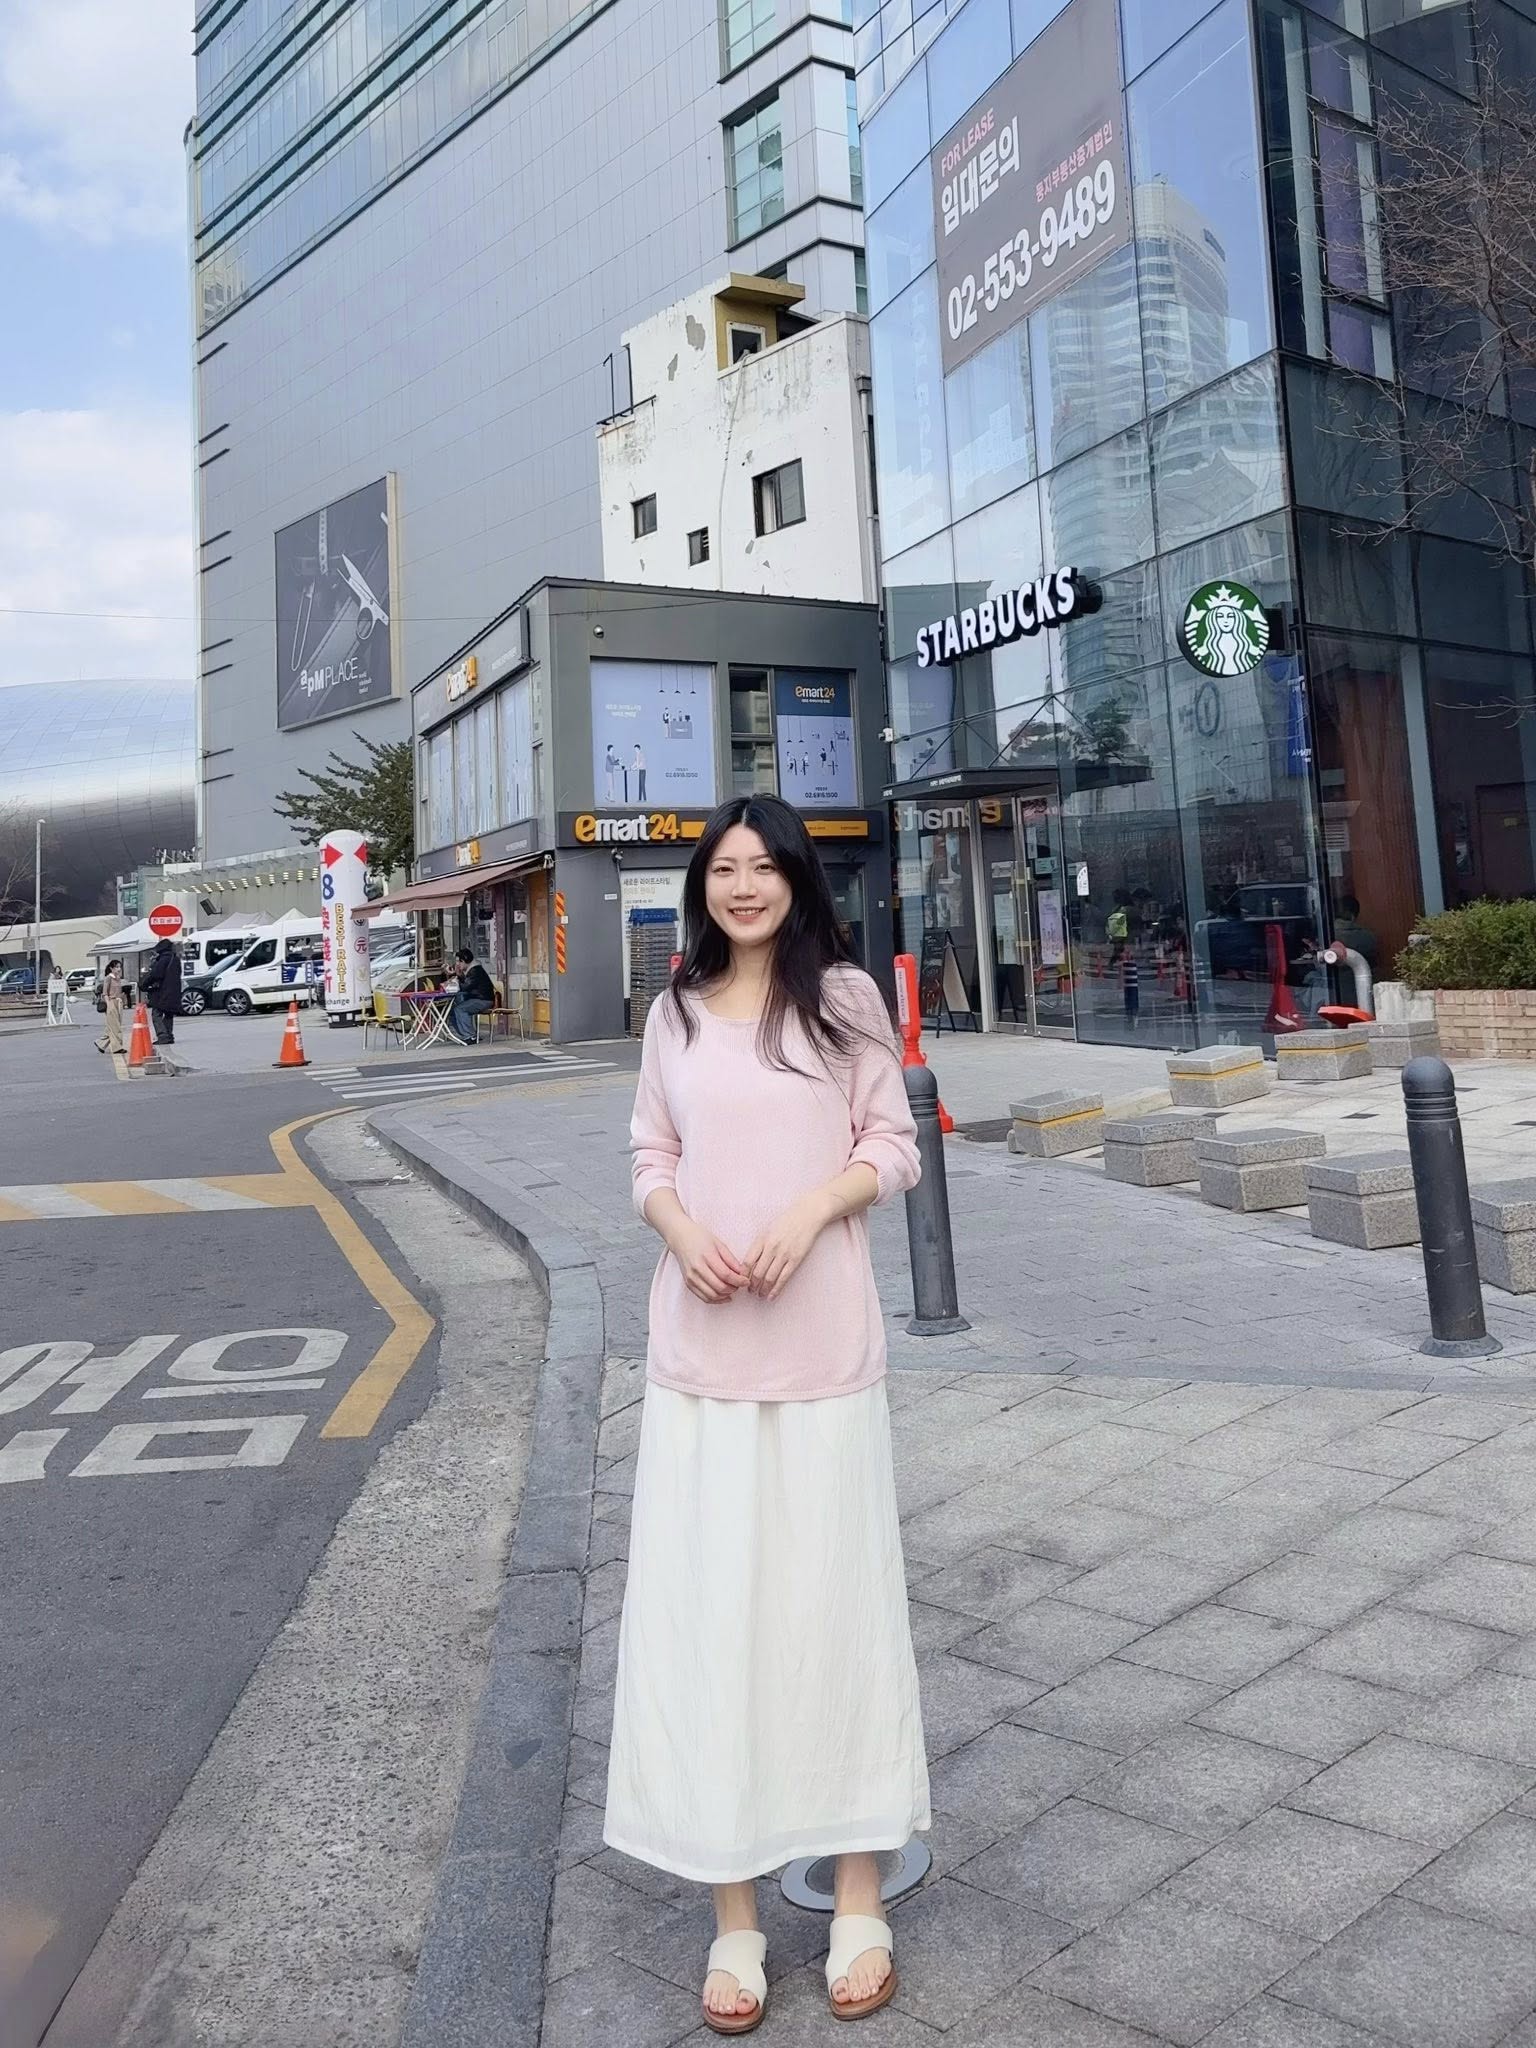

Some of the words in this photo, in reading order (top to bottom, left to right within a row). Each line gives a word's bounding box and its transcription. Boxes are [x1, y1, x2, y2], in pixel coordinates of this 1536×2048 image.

[941, 143, 961, 177] FOR
[962, 107, 995, 156] LEASE
[941, 115, 1020, 237] 임대문의
[947, 159, 1116, 341] 02-553-9489
[916, 565, 1075, 668] STARBUCKS
[795, 686, 836, 698] emart24
[575, 813, 680, 842] emart24
[322, 873, 335, 900] 8
[334, 903, 344, 947] BEST
[336, 949, 347, 994] RATE
